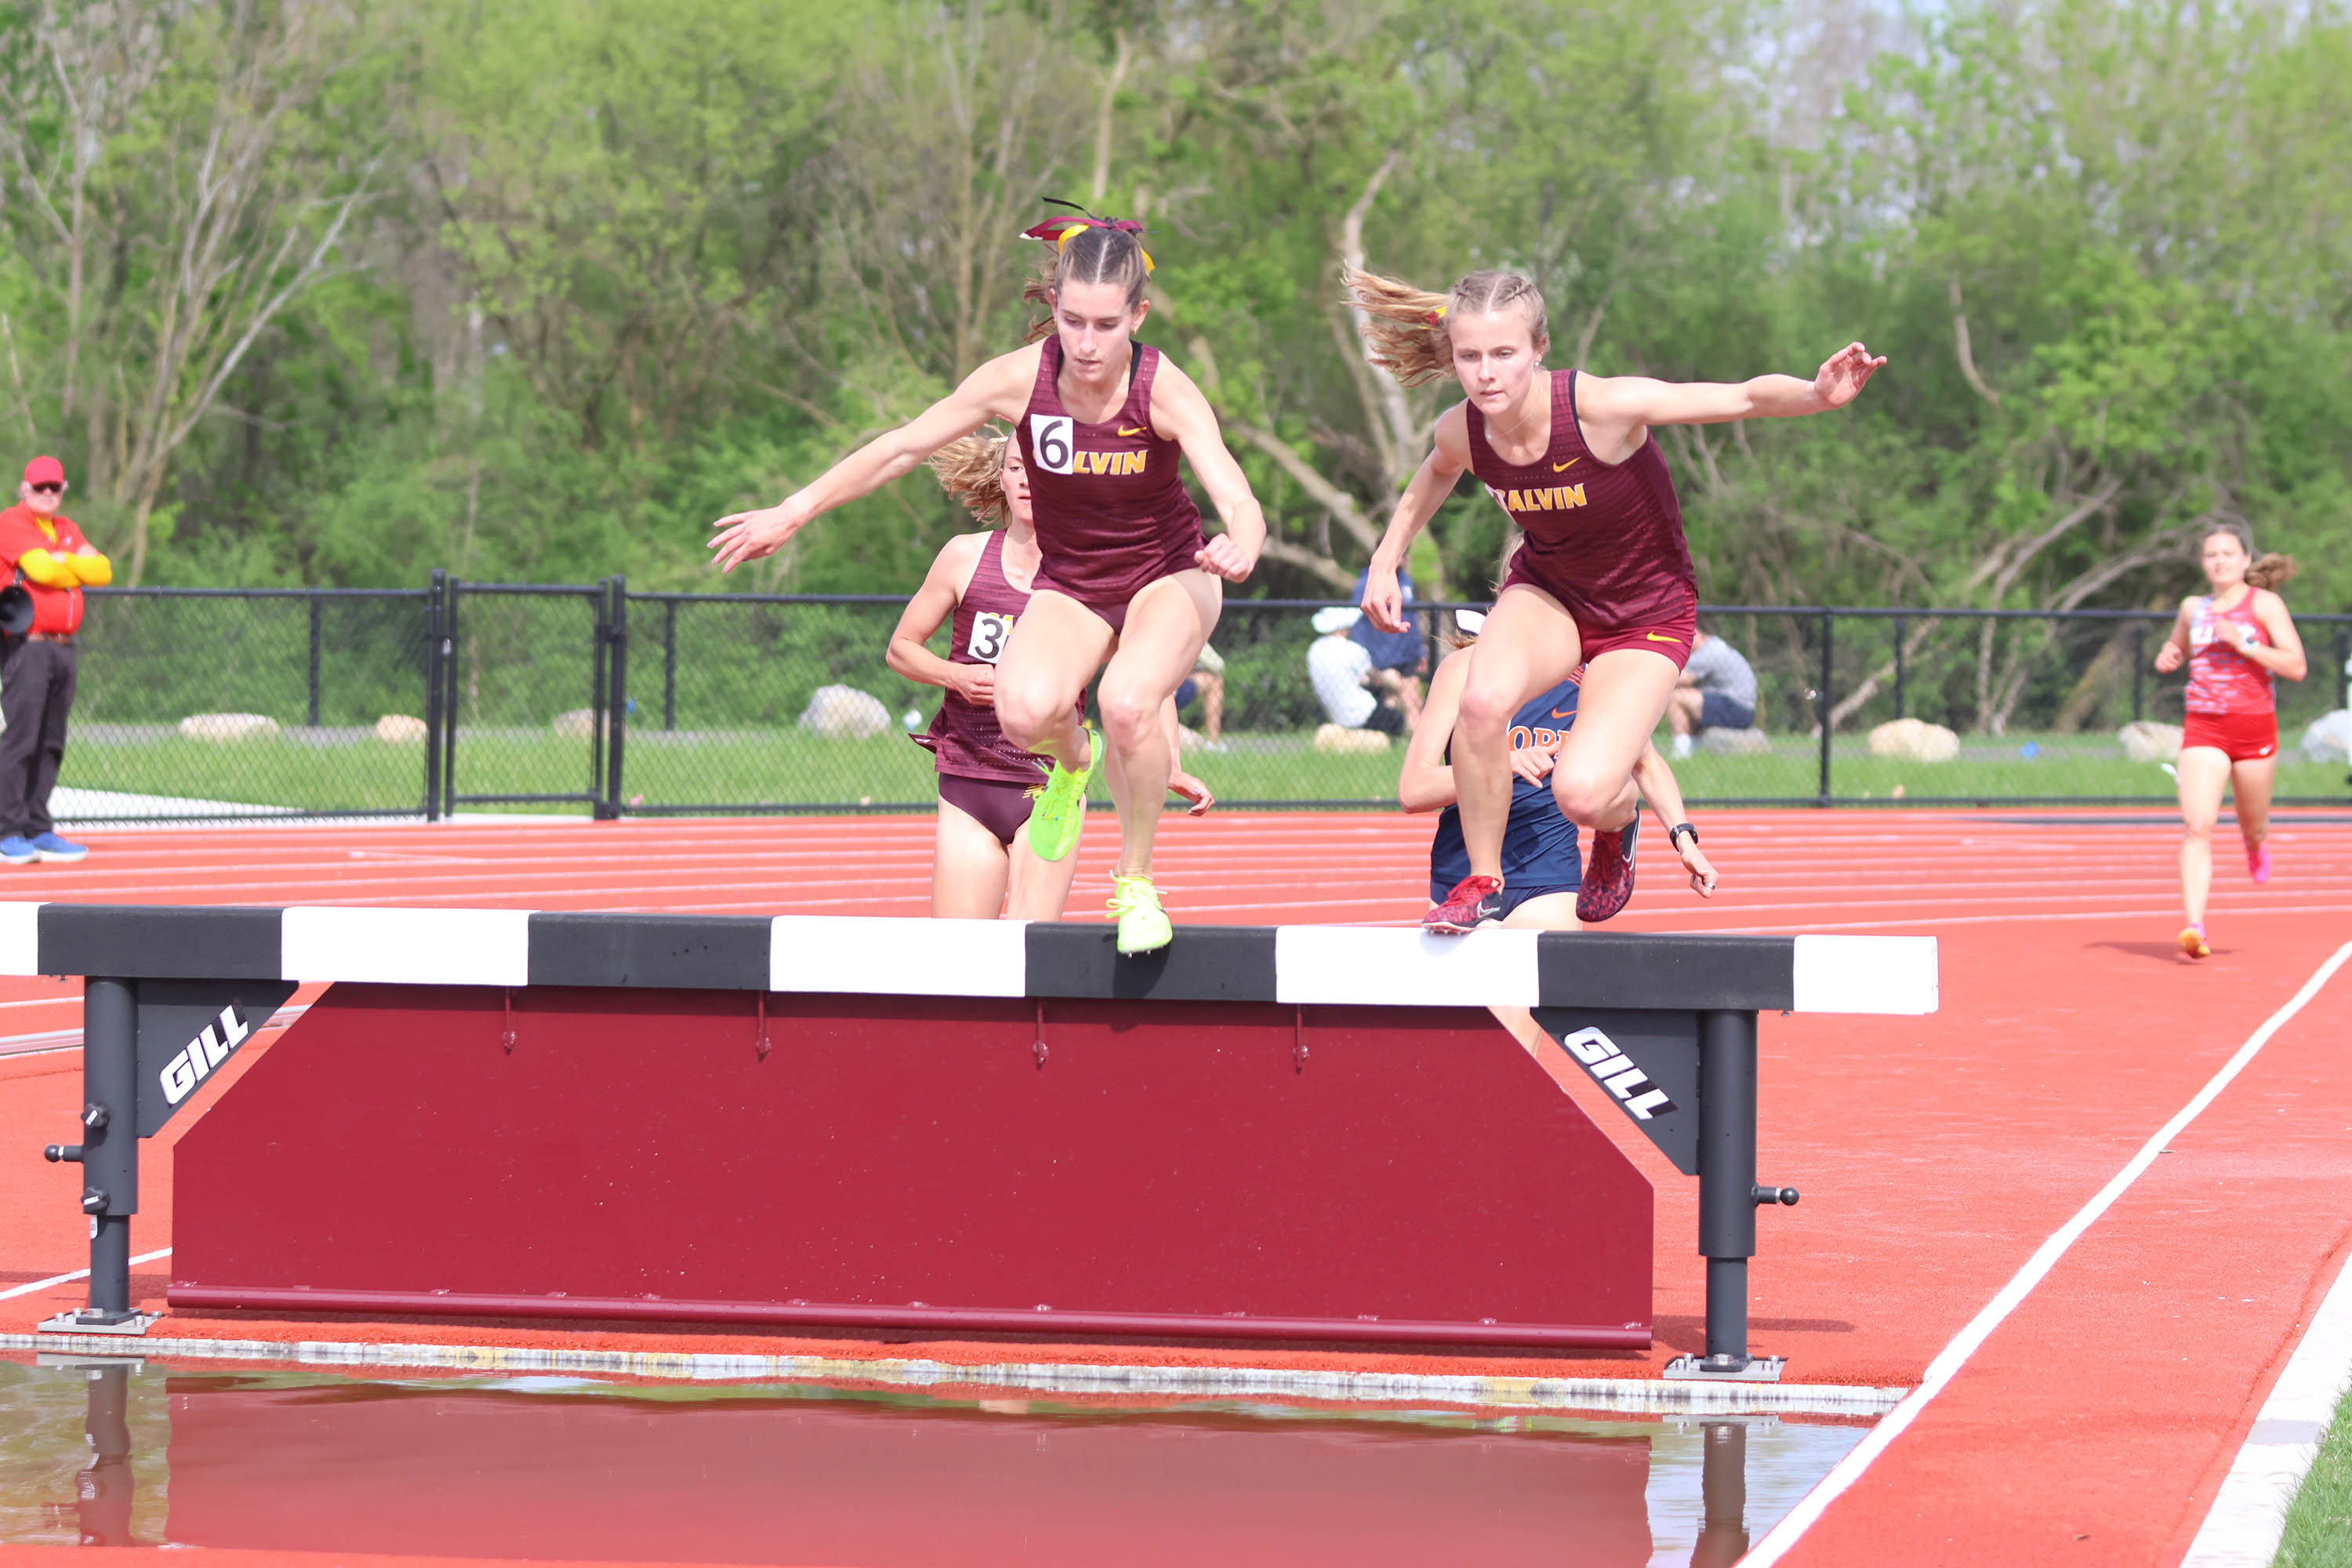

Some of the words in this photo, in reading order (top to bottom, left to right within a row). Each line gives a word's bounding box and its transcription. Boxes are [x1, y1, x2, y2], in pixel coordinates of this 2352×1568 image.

[1040, 419, 1069, 470] 6
[1073, 449, 1148, 475] LVIN
[1494, 483, 1588, 511] ALVIN
[974, 618, 1004, 659] 3
[159, 1004, 249, 1104] GILL
[1564, 1025, 1669, 1120] GILL
